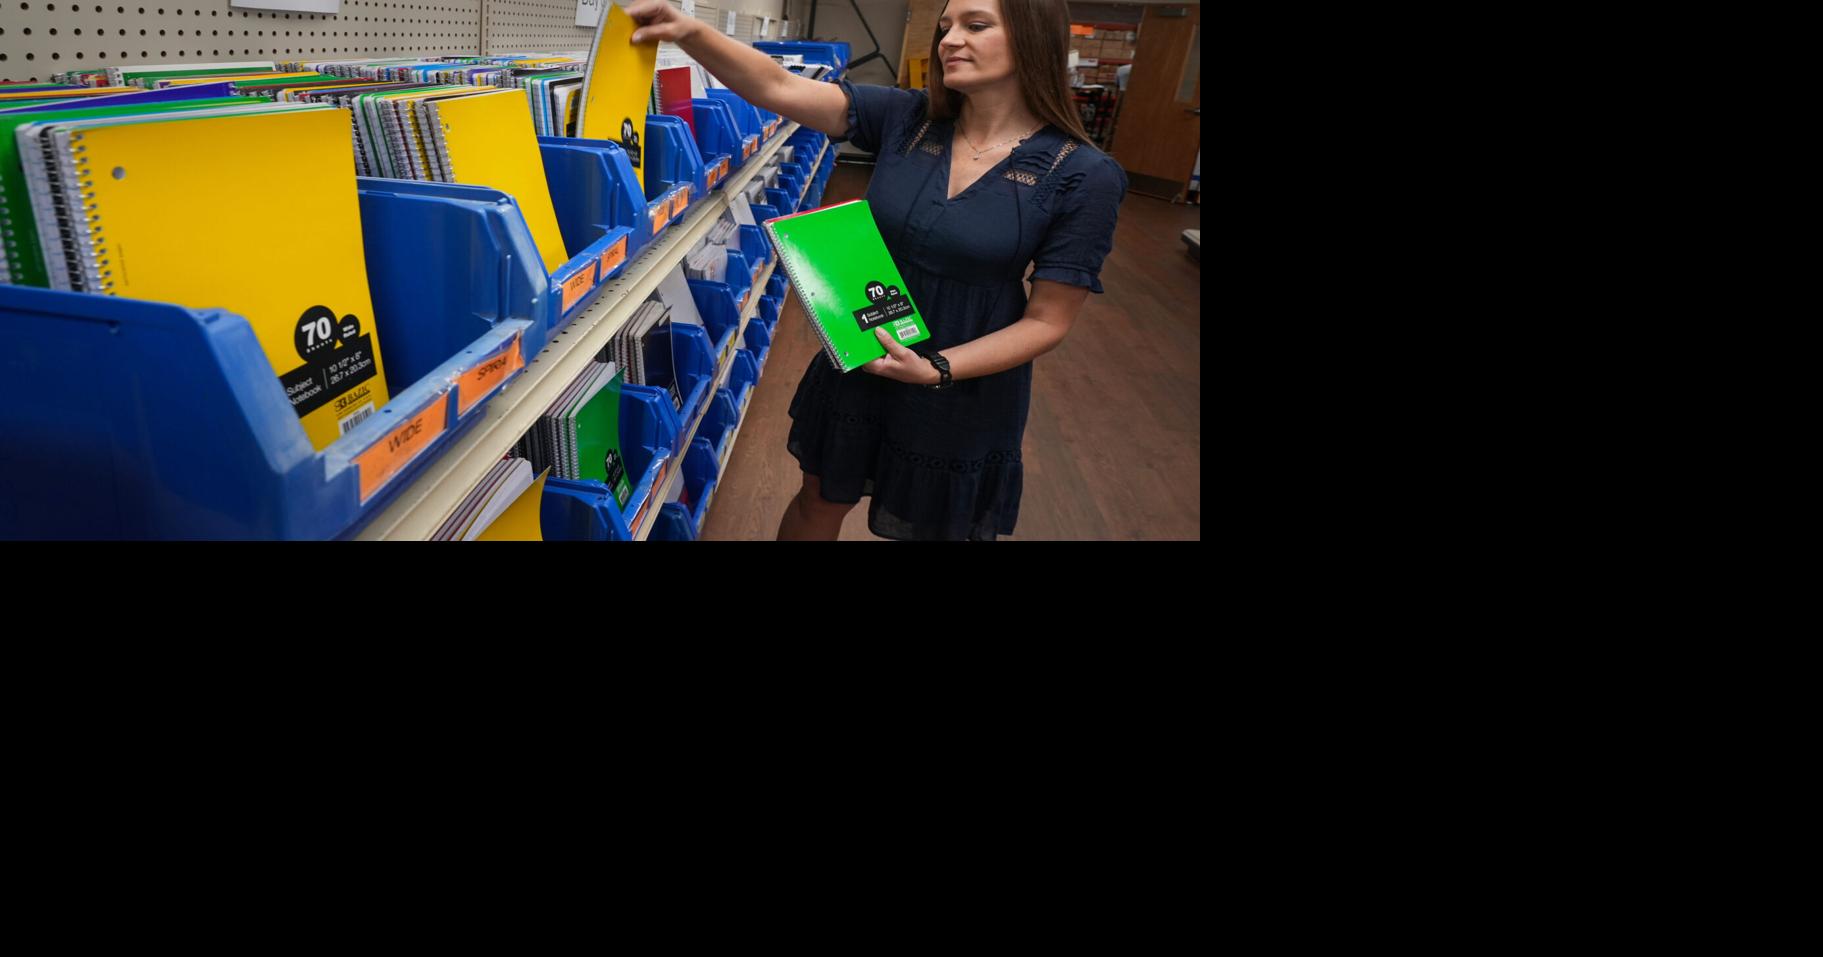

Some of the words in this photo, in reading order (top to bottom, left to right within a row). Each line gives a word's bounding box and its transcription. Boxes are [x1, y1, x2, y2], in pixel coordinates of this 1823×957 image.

[868, 285, 884, 298] 70
[861, 313, 869, 324] 1
[301, 316, 332, 347] 70
[286, 377, 313, 397] Subject
[388, 418, 423, 453] WIDE
